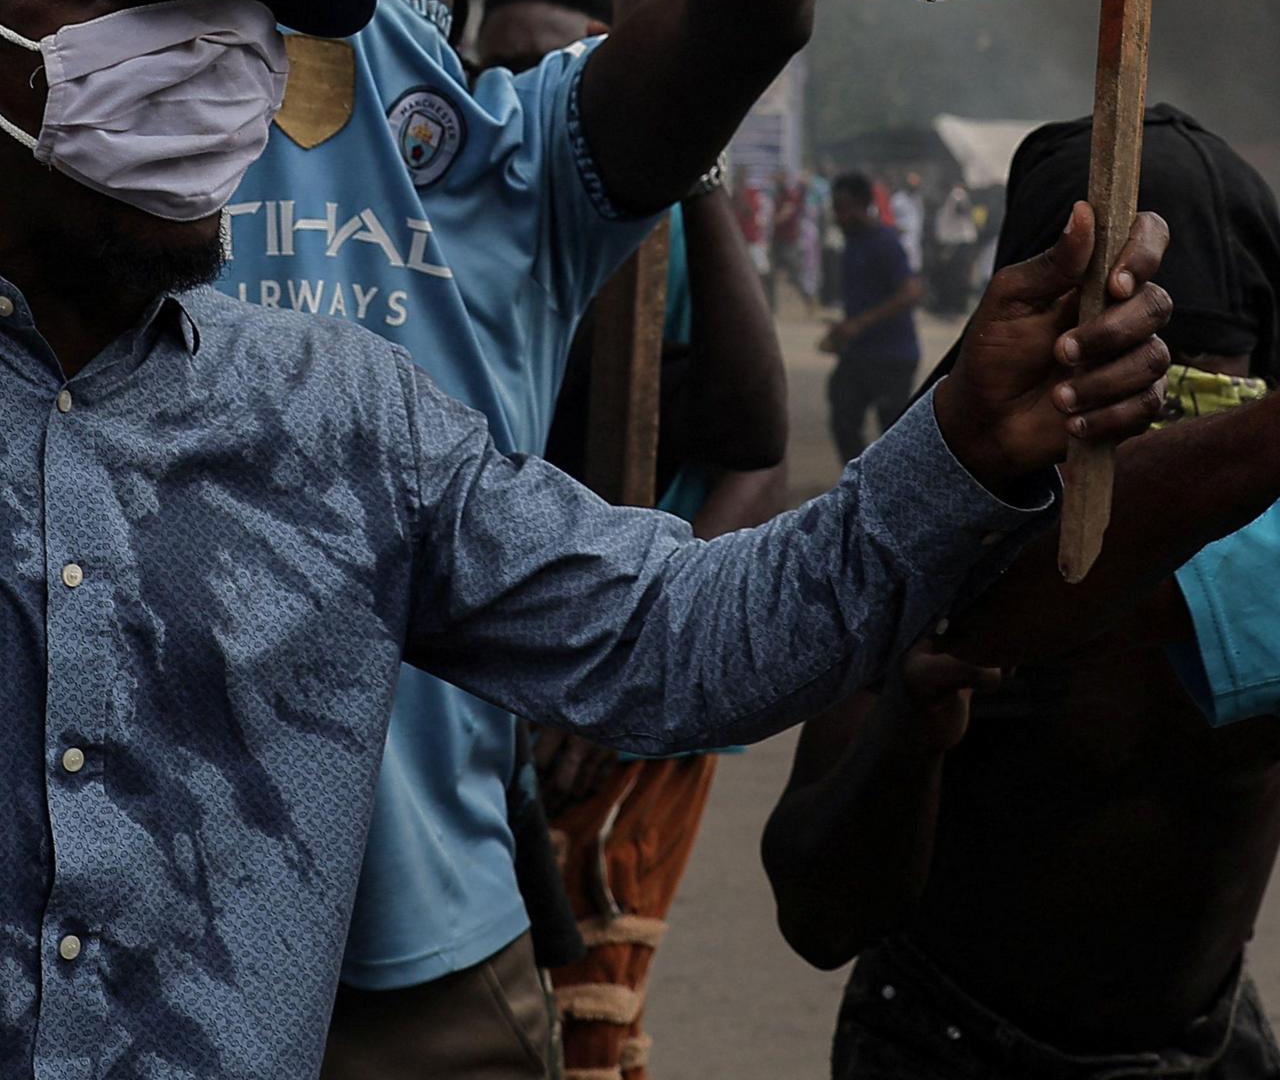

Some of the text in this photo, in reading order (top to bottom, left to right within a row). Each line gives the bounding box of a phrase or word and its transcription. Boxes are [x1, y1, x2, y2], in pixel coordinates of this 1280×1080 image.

[400, 98, 457, 140] MANCHESTER
[219, 199, 454, 279] TIHAD
[238, 278, 409, 327] IRWAYS
